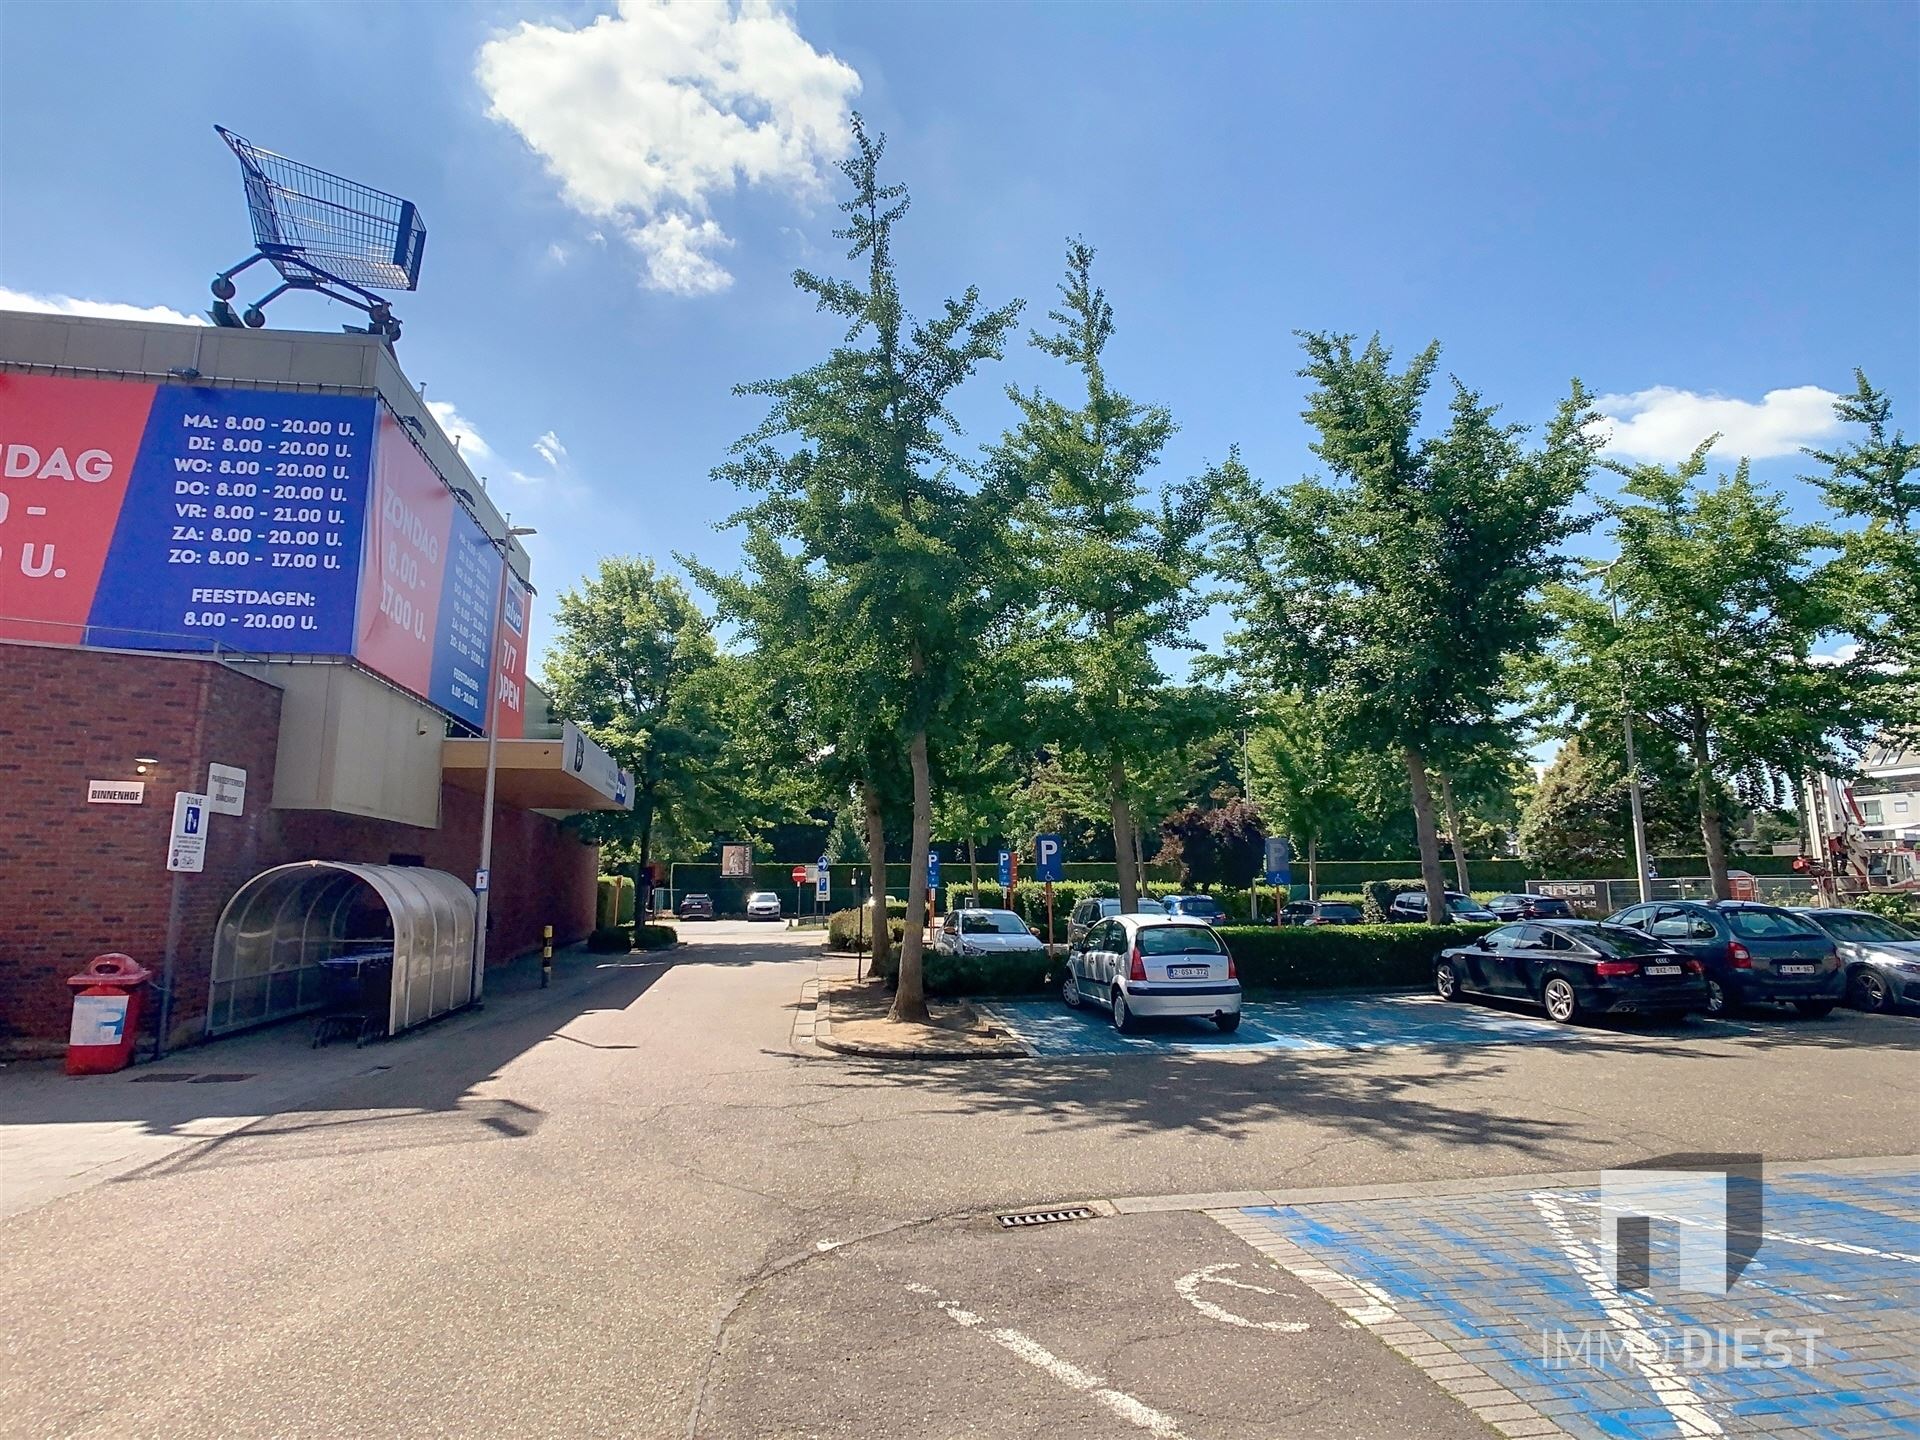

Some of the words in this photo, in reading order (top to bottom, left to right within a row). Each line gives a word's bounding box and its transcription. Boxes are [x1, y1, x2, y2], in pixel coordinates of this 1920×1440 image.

[183, 414, 219, 429] MA:
[225, 416, 265, 431] 8.00
[281, 419, 332, 435] 20.00
[338, 422, 355, 436] U.
[188, 436, 216, 450] DI:
[222, 438, 262, 453] 8.00
[278, 441, 329, 457] 20.00
[335, 444, 352, 458] U.
[0, 444, 113, 483] DAG
[174, 458, 213, 473] WO:
[219, 460, 260, 475] 8.00
[275, 463, 326, 479] 20.00
[333, 466, 350, 480] U.
[175, 480, 210, 496] DO:
[216, 482, 257, 497] 8.00
[273, 485, 324, 501] 20.00
[330, 488, 347, 502] U.
[175, 503, 207, 518] VR:
[213, 505, 254, 520] 8.00
[272, 507, 321, 523] 21.00
[328, 510, 345, 524] U.
[383, 484, 439, 564] ZONDAG
[172, 526, 204, 541] ZA:
[210, 527, 252, 543] 8.00
[268, 530, 319, 546] 20.00
[325, 532, 343, 547] U.
[21, 543, 66, 578] U.
[168, 549, 201, 564] ZO:
[208, 551, 249, 566] 8.00
[271, 553, 317, 568] 17.00
[323, 555, 341, 569] U.
[389, 540, 417, 590] 8.00
[191, 588, 316, 607] FEESTDAGEN:
[184, 612, 226, 627] 8.00
[243, 614, 295, 629] 20.00
[300, 616, 318, 630] U.
[380, 579, 412, 631] 17.00
[414, 608, 426, 643] U.
[503, 639, 517, 674] 7/7
[91, 790, 140, 800] BINNENHOF
[186, 796, 203, 806] ZONE
[928, 854, 938, 868] P
[1000, 853, 1009, 866] P
[1041, 840, 1058, 865] P
[1269, 843, 1286, 867] P
